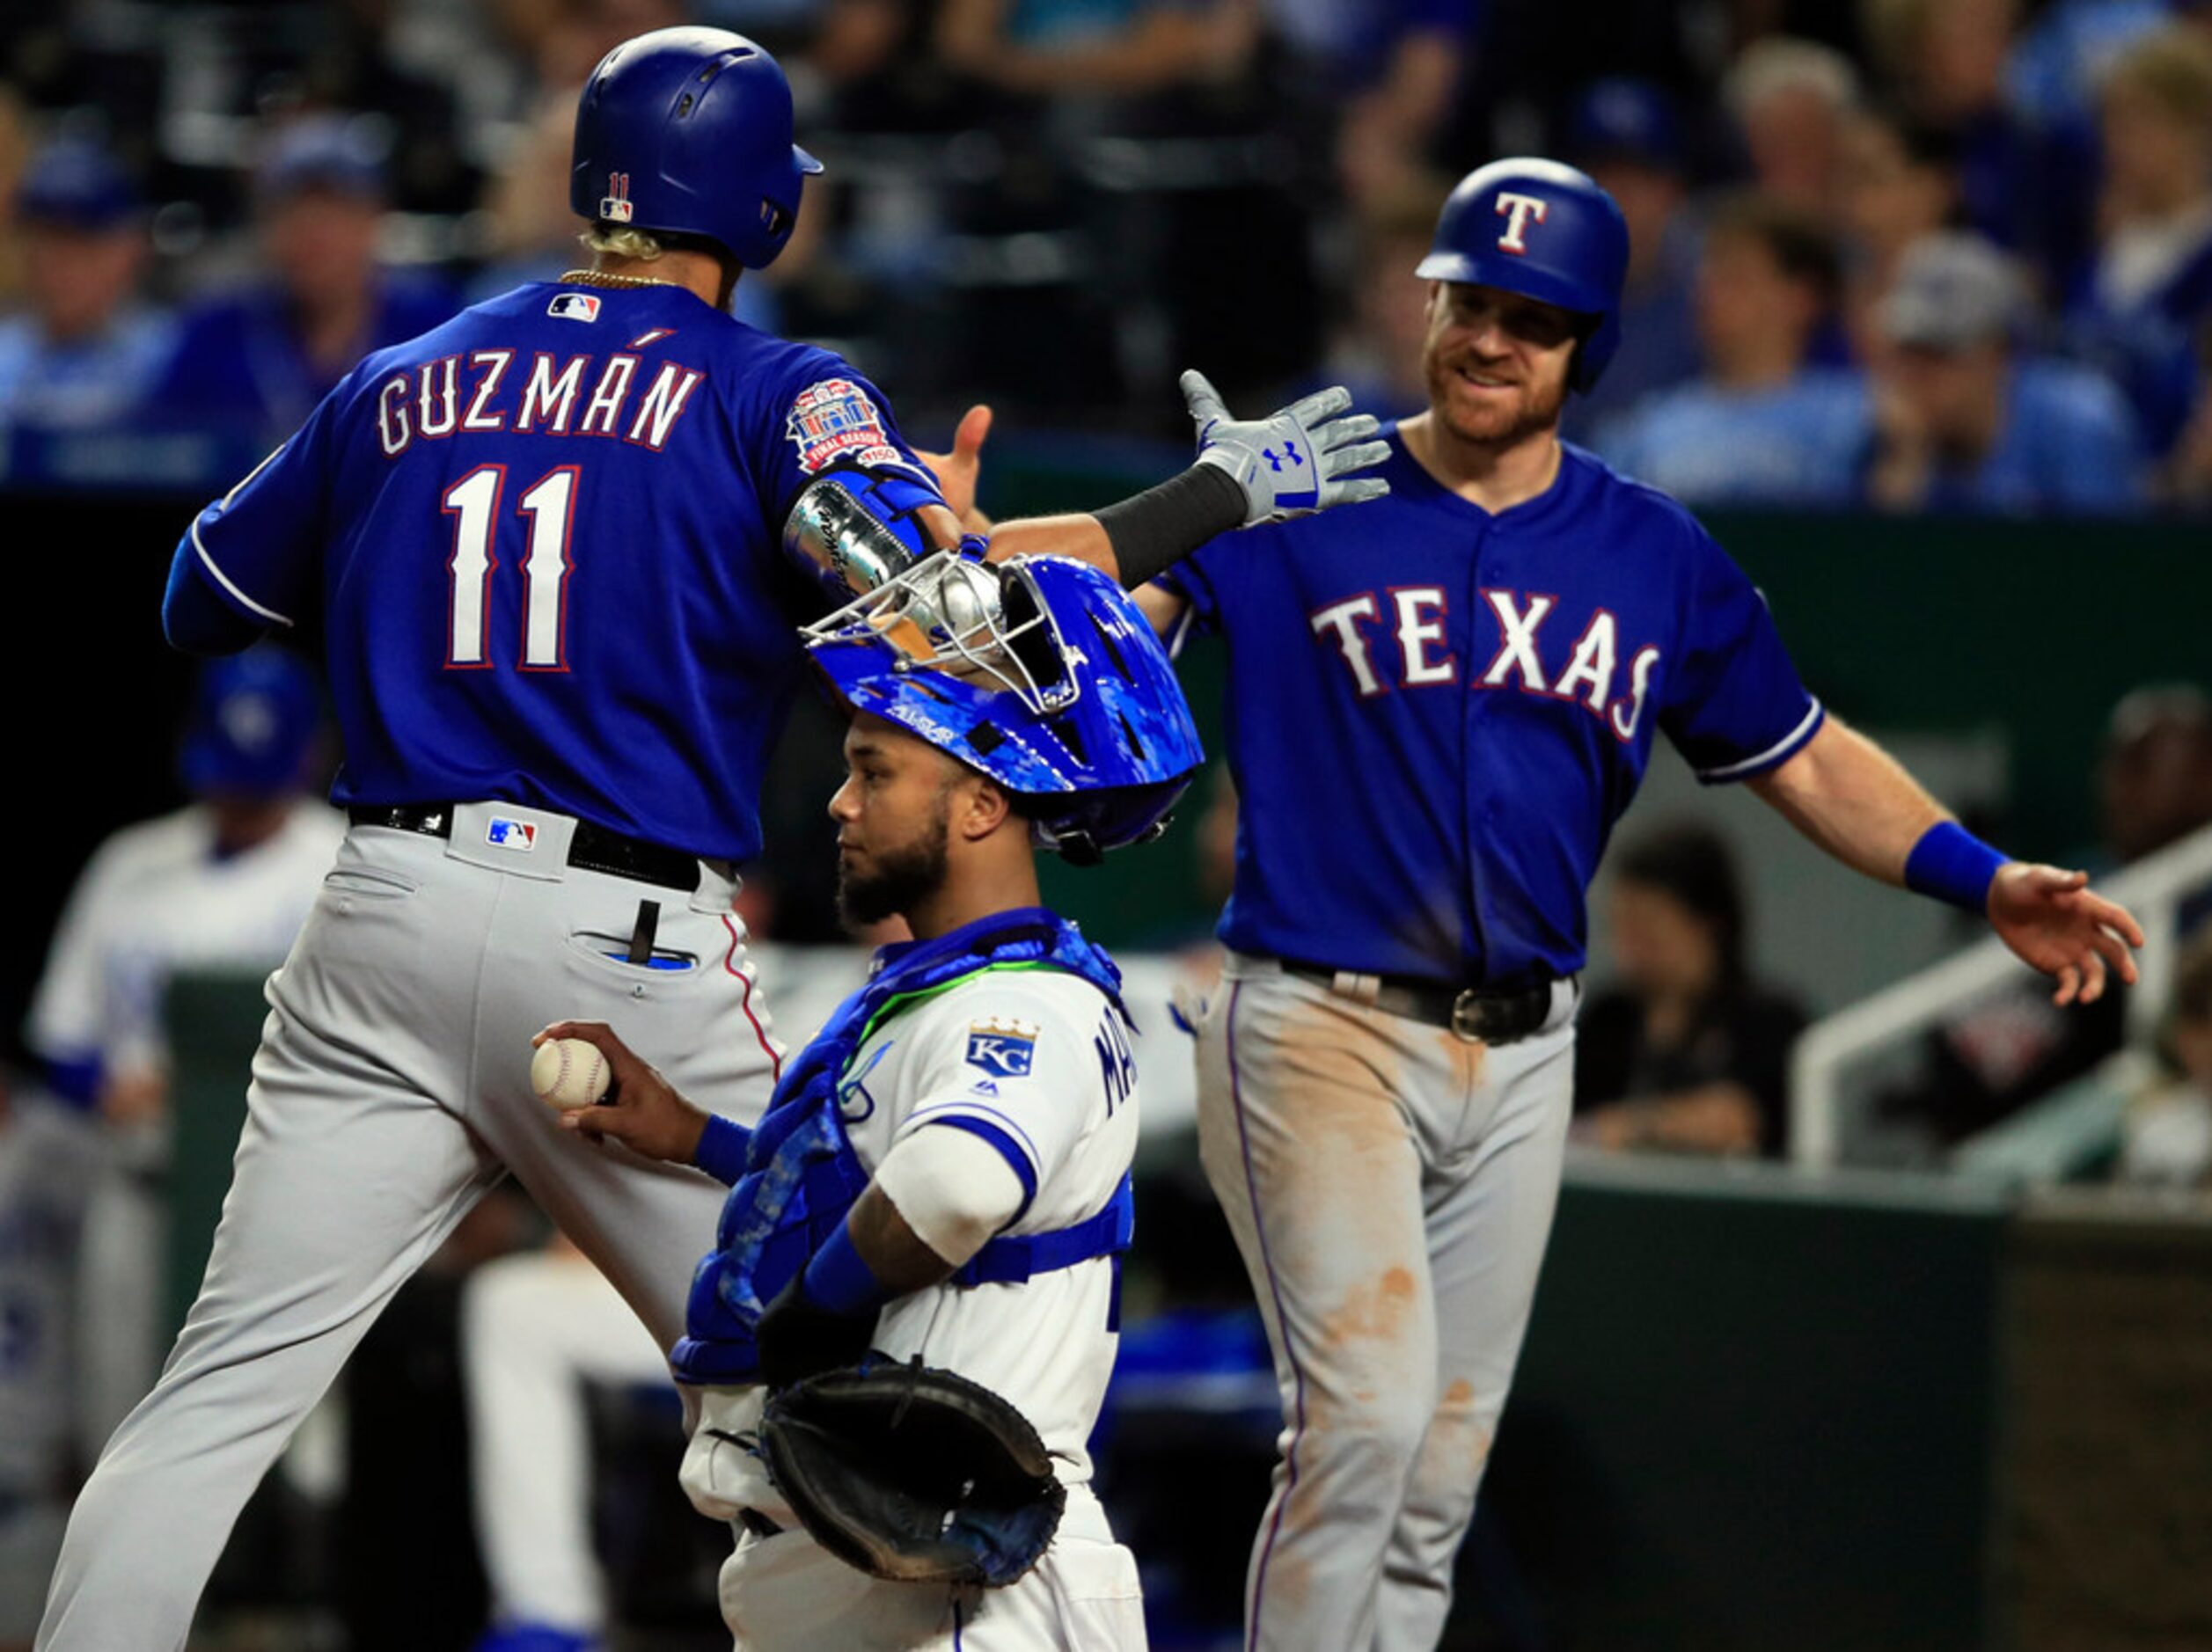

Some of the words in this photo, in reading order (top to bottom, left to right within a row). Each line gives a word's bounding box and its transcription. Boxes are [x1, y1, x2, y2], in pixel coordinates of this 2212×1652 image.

[608, 172, 629, 200] 11
[1494, 191, 1549, 255] T
[377, 328, 706, 460] GUZMÁN
[809, 437, 842, 462] FINAL
[839, 430, 880, 447] SEASON
[440, 463, 582, 673] 11
[1309, 585, 1661, 743] TEXAS
[969, 1038, 1029, 1073] KC
[1093, 1005, 1138, 1120] MA
